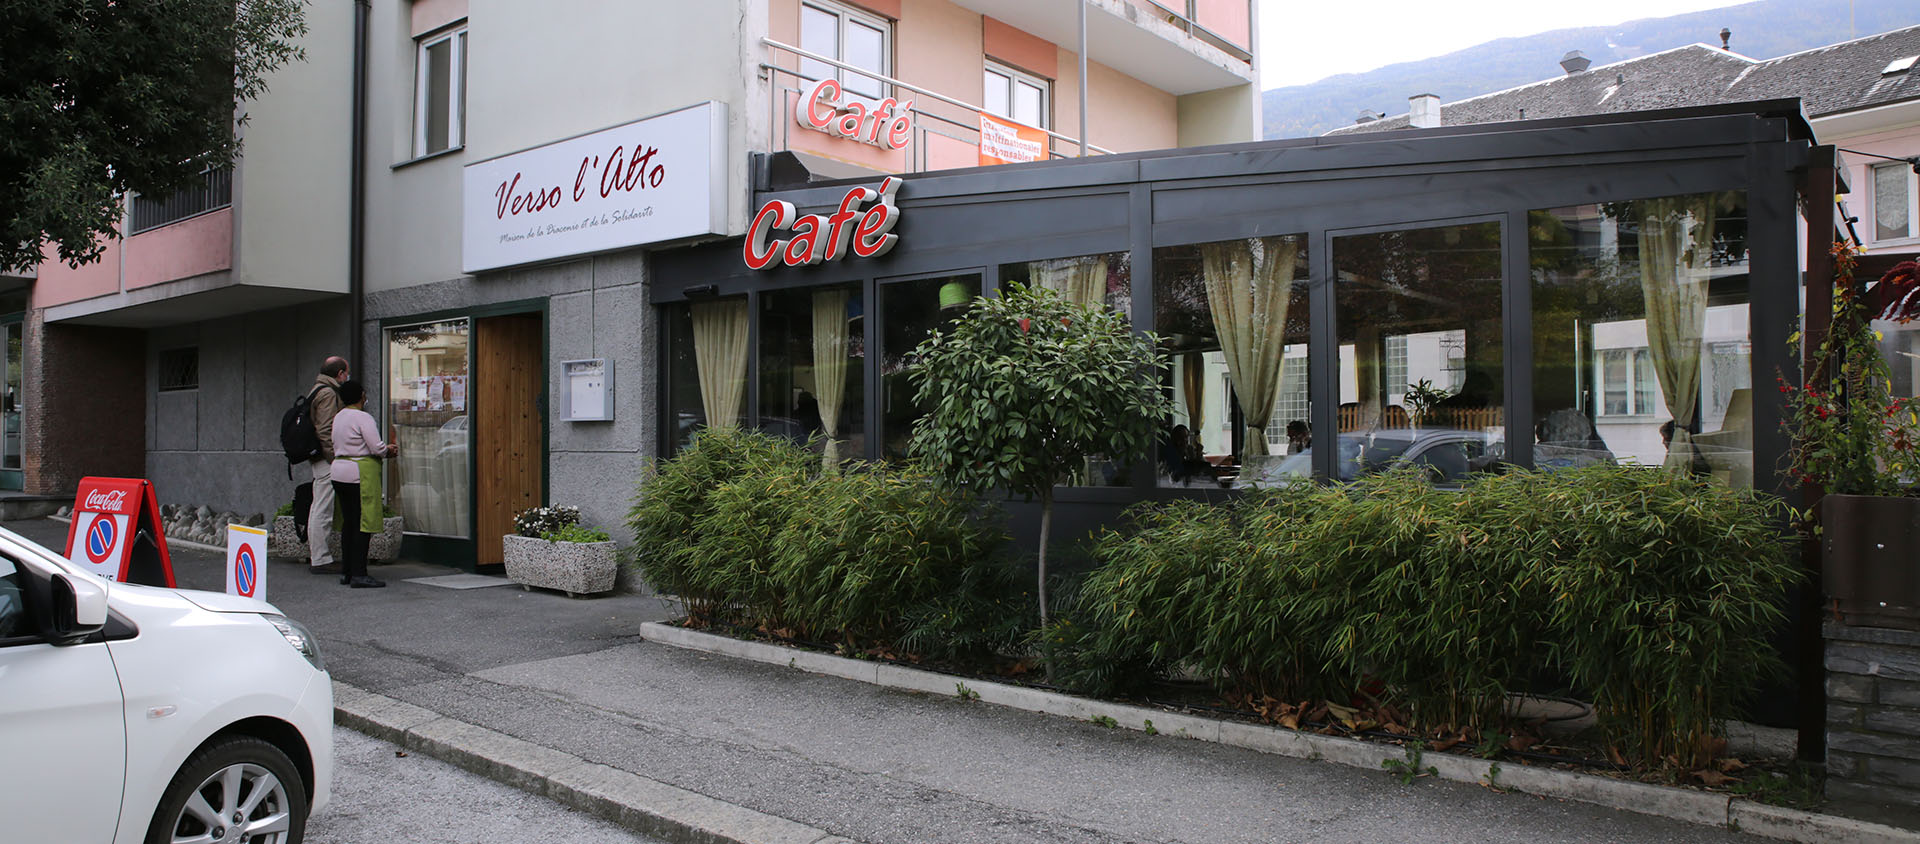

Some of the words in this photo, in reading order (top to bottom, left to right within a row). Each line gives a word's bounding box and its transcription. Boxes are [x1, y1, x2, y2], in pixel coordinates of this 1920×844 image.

[802, 78, 914, 150] Café
[983, 144, 1032, 162] responsables
[495, 172, 562, 220] Verso
[573, 144, 665, 203] l'Alto
[500, 233, 525, 244] Maison
[526, 227, 535, 239] de
[537, 226, 544, 238] la
[547, 223, 579, 236] Diaconie
[580, 217, 589, 230] et
[590, 215, 599, 227] de
[600, 211, 609, 226] la
[611, 206, 654, 225] Solidarité
[743, 175, 903, 271] Café
[85, 488, 128, 511] Coca-Cola
